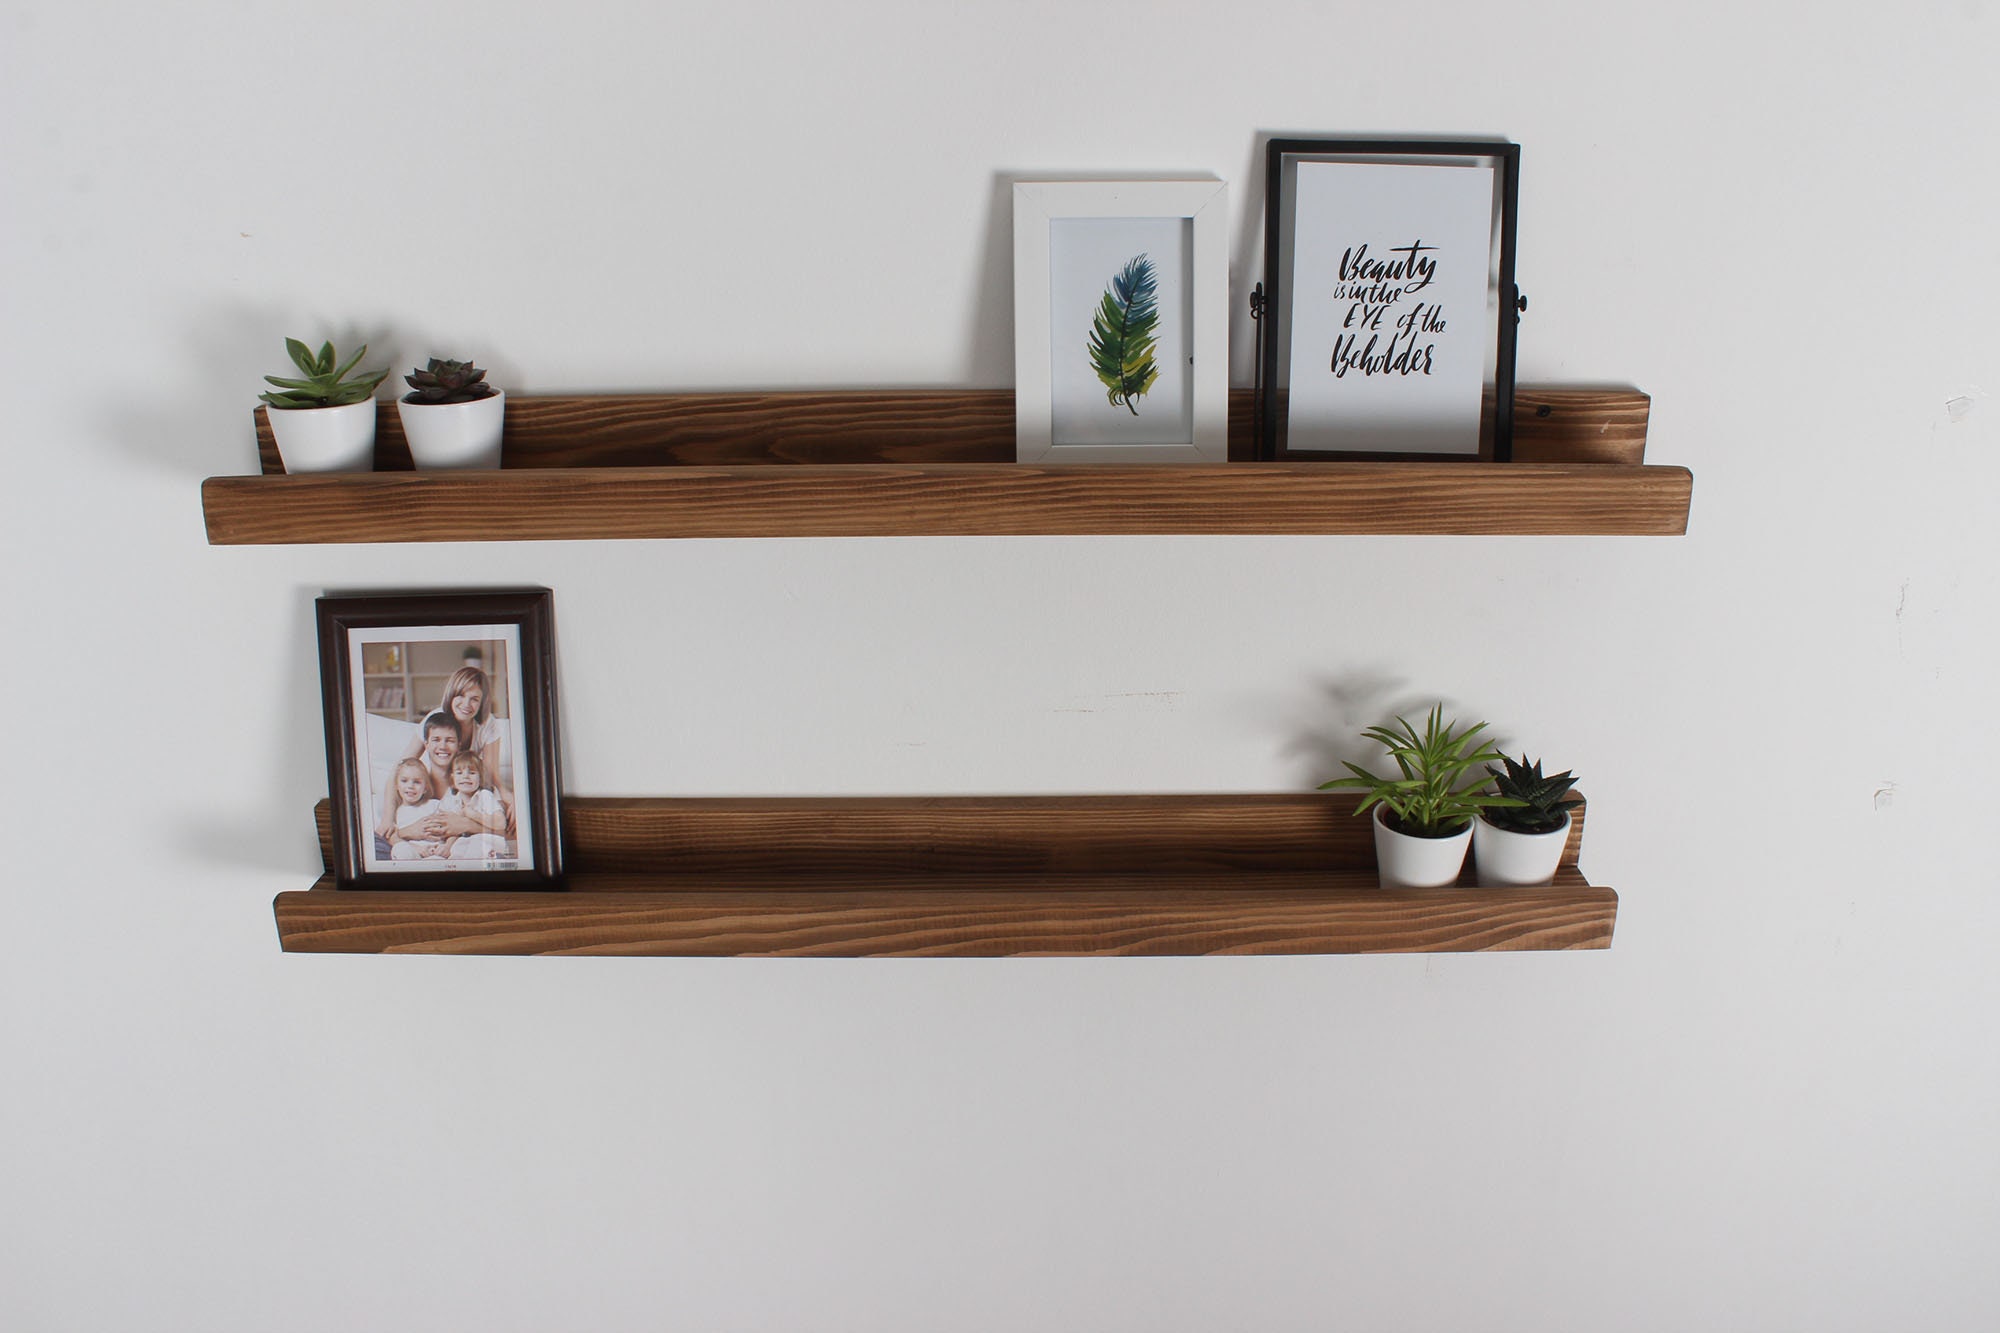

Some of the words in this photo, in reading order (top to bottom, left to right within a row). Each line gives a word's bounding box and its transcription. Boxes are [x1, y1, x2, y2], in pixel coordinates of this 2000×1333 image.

[1338, 239, 1440, 293] Beauty
[1333, 282, 1346, 299] is
[1343, 302, 1391, 331] EYE
[1397, 302, 1425, 340] of
[1421, 304, 1446, 333] the
[1331, 331, 1434, 378] Beholder
